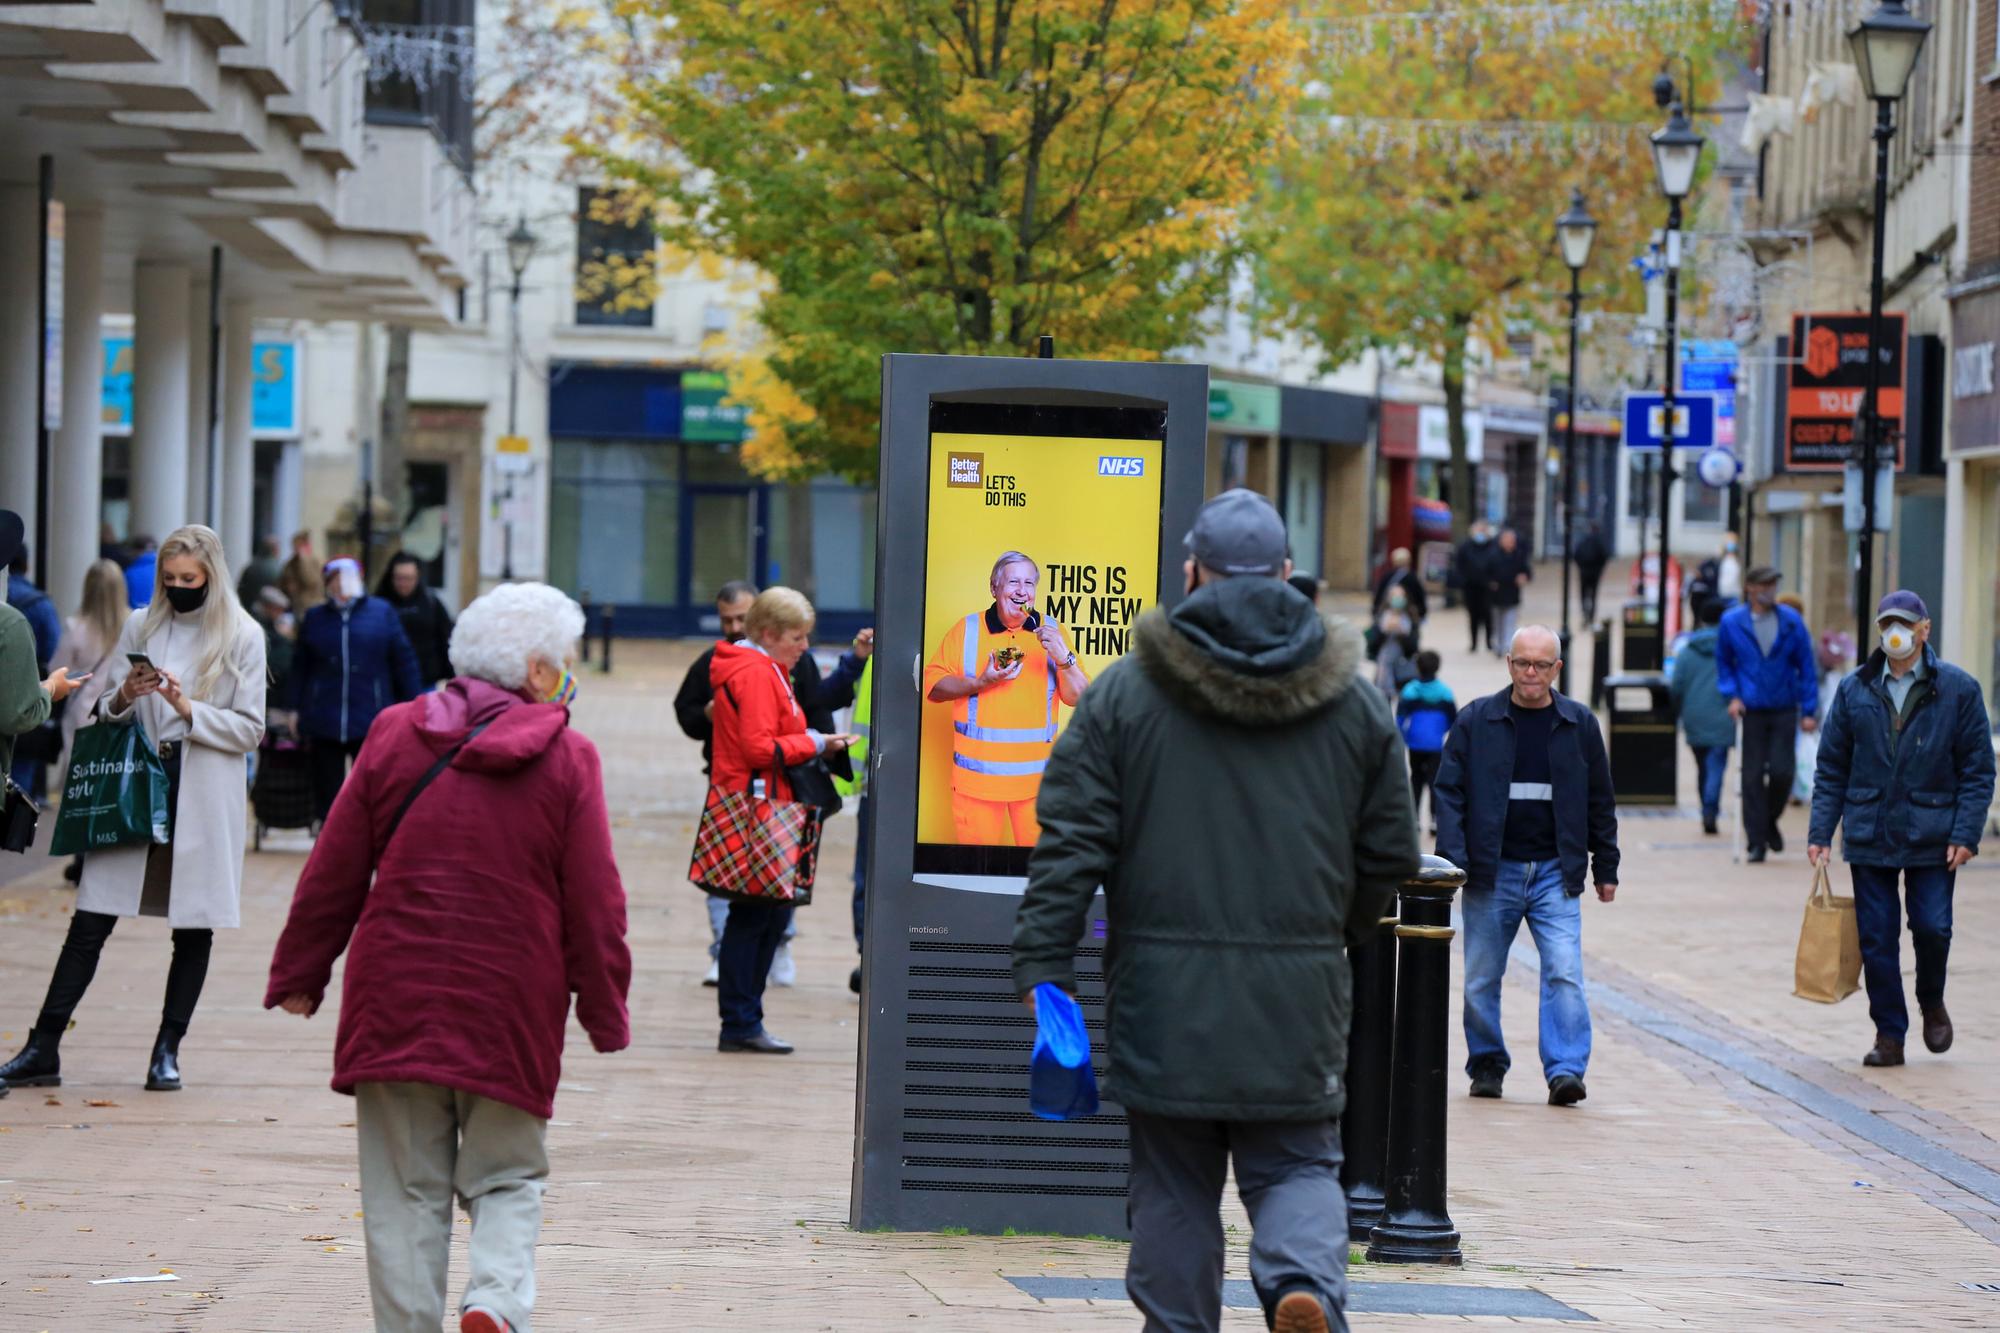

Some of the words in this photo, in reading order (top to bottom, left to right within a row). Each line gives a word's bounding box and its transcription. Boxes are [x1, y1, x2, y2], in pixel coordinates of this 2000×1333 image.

[1818, 391, 1841, 413] TO
[951, 457, 980, 471] Better
[1100, 458, 1142, 475] NHS
[950, 469, 980, 483] Health
[986, 475, 1016, 490] LET'S
[985, 491, 1001, 506] DO
[1002, 492, 1026, 507] THIS
[1046, 564, 1097, 594] THIS
[1105, 566, 1127, 595] IS
[1046, 595, 1082, 624] MY
[1089, 596, 1142, 626] NEW
[96, 831, 118, 845] M&S
